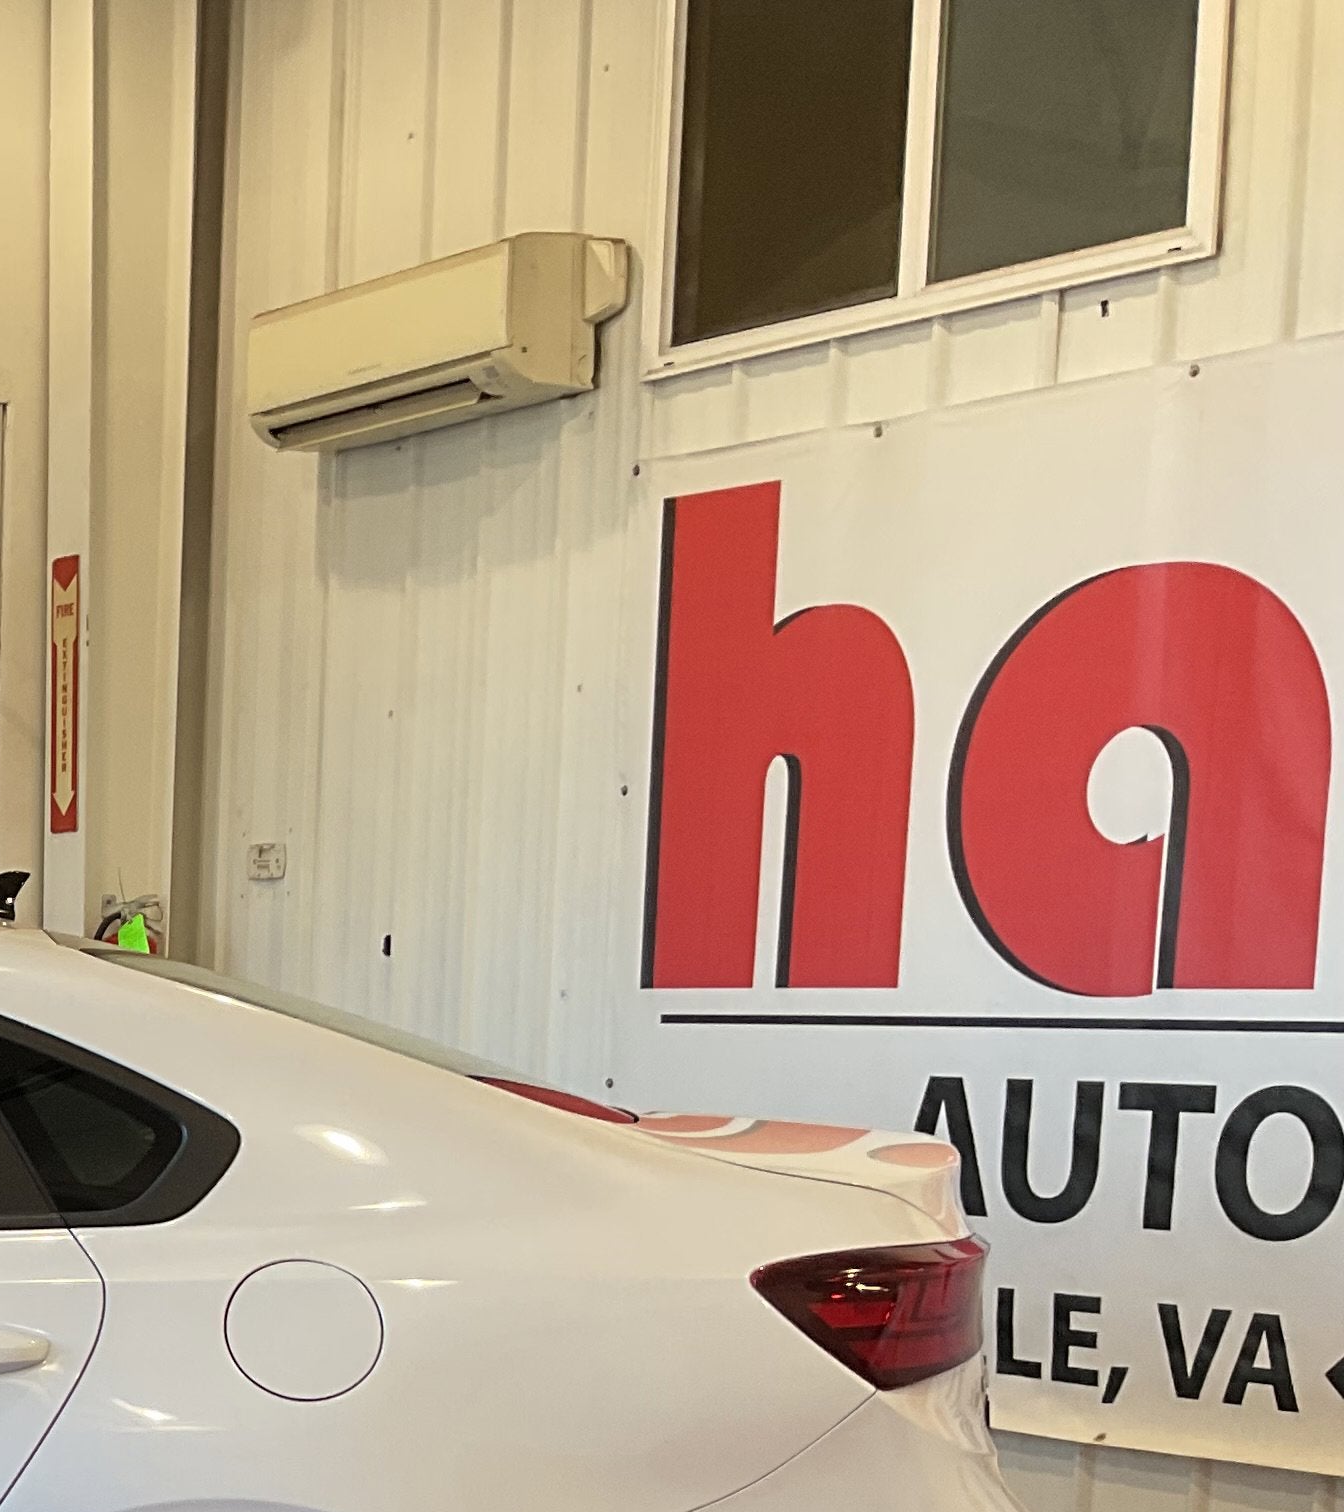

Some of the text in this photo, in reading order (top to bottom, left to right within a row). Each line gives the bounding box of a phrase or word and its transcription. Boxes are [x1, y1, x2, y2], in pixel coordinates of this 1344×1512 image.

[55, 602, 74, 618] FIRE
[640, 480, 1332, 998] ha
[913, 1075, 1344, 1242] AUTO
[1157, 1303, 1300, 1413] VA
